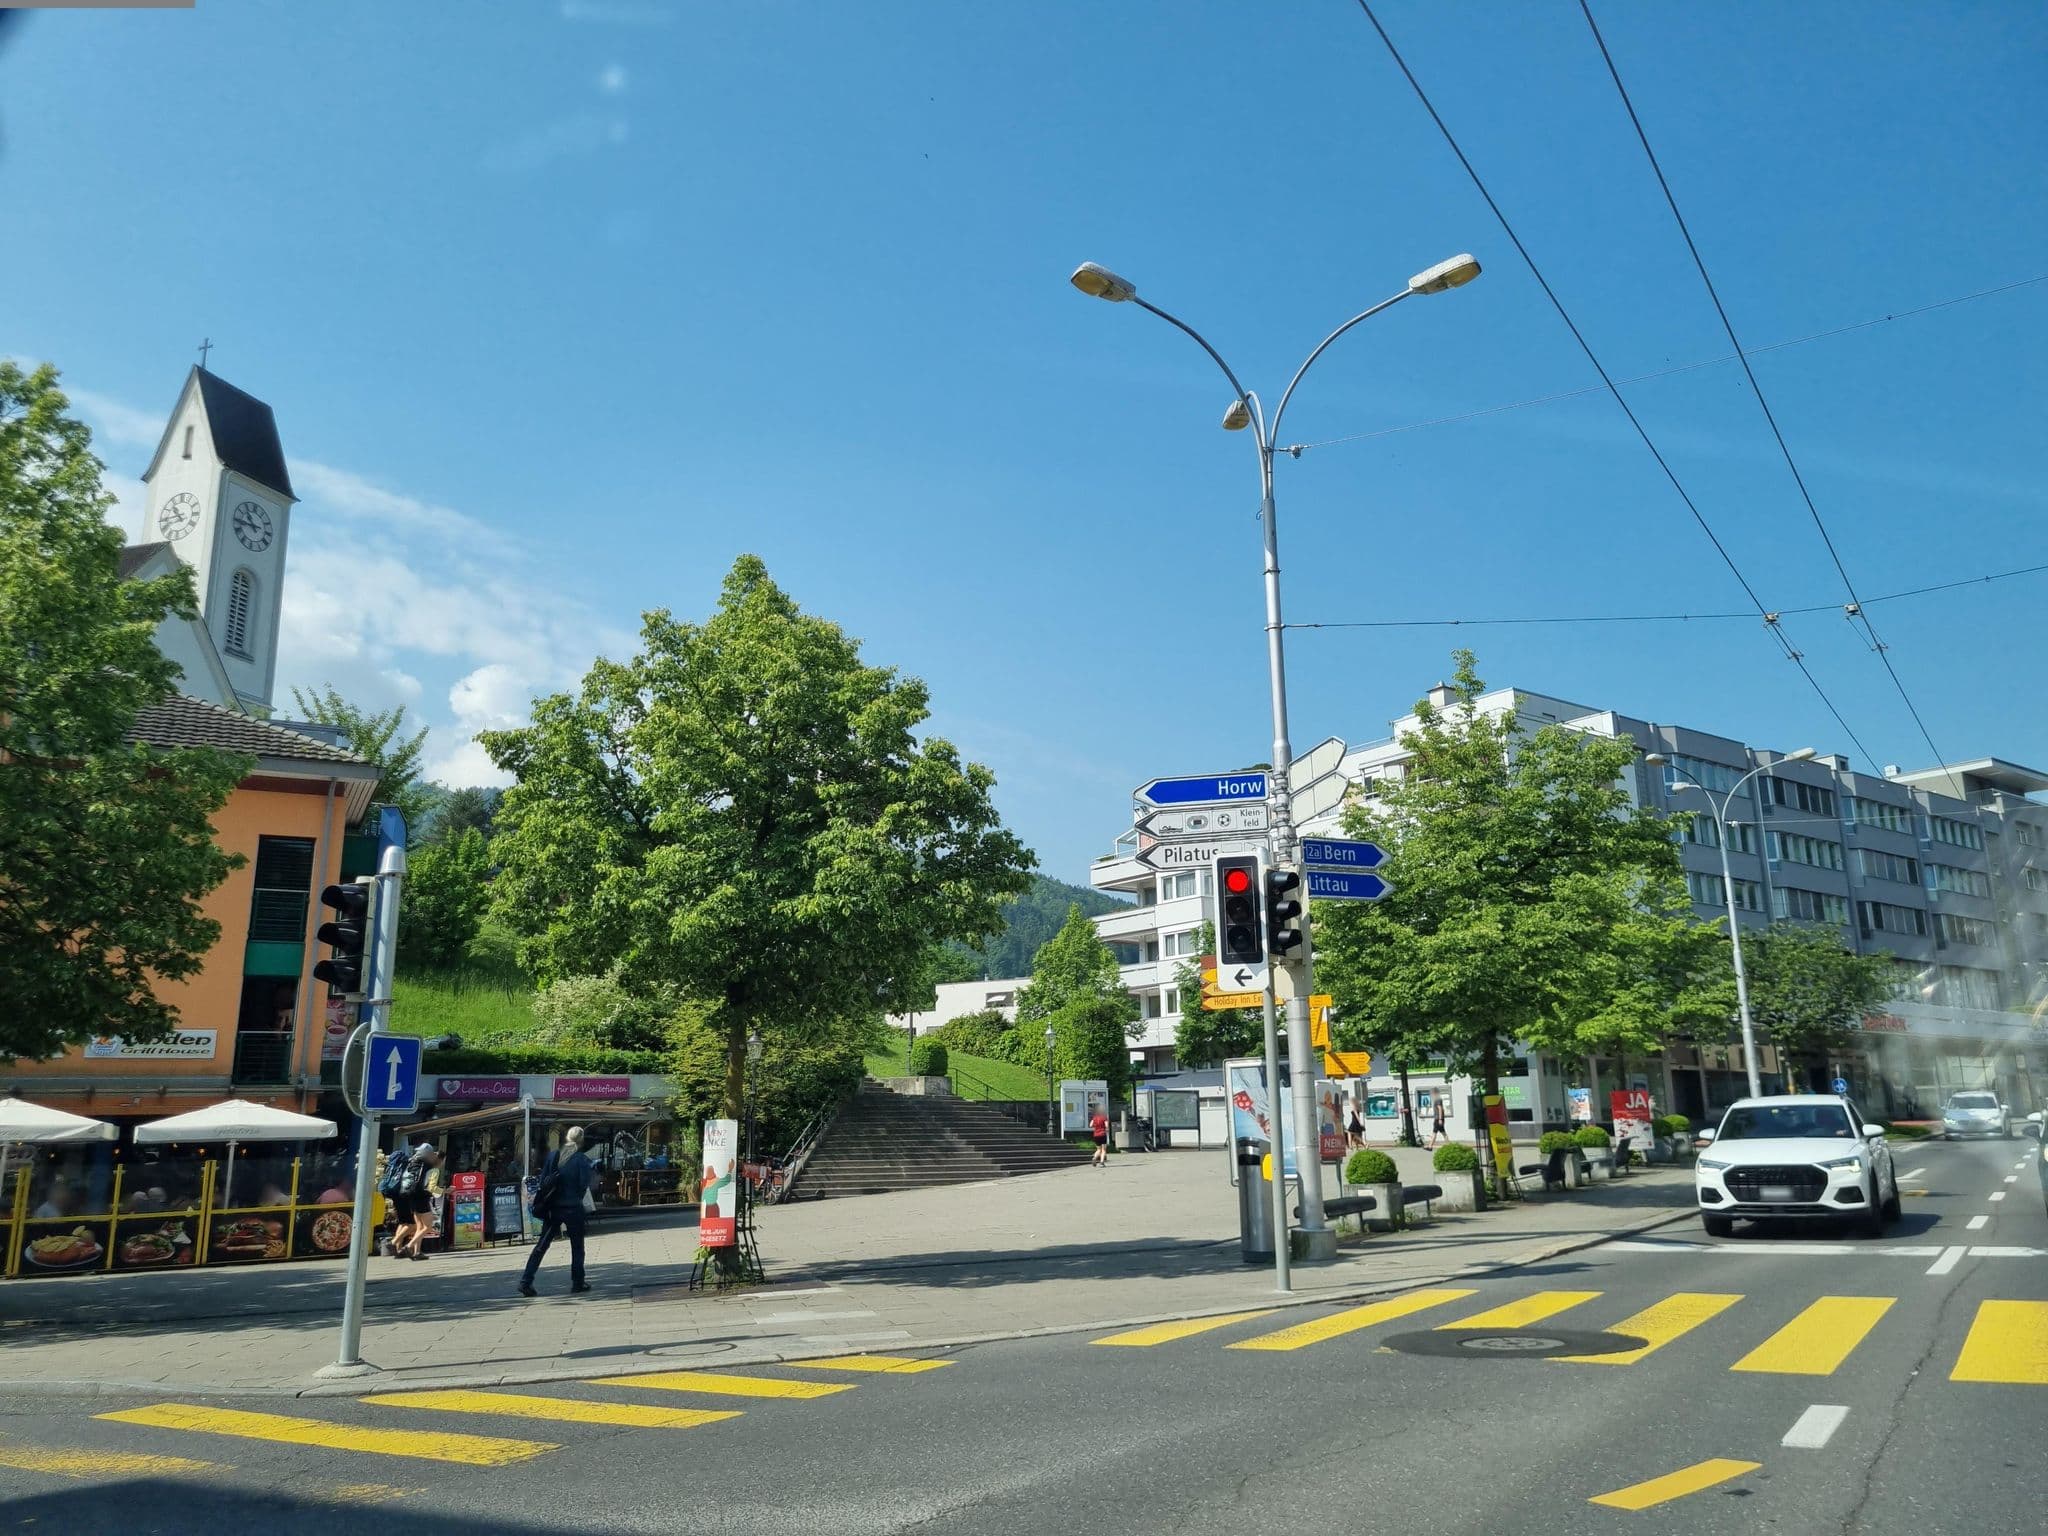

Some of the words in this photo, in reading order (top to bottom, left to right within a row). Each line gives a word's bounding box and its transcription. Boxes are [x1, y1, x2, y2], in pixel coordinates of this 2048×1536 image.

[1217, 780, 1262, 796] Horw
[1240, 808, 1264, 817] Klein-
[1243, 819, 1260, 828] feld
[1308, 846, 1320, 857] 2a
[1324, 844, 1356, 861] Bern
[1308, 874, 1349, 893] Littau
[1214, 996, 1238, 1007] Holiday
[1240, 995, 1251, 1004] Inn
[121, 1047, 155, 1055] Grill
[158, 1047, 210, 1055] House
[1625, 1093, 1647, 1109] JA
